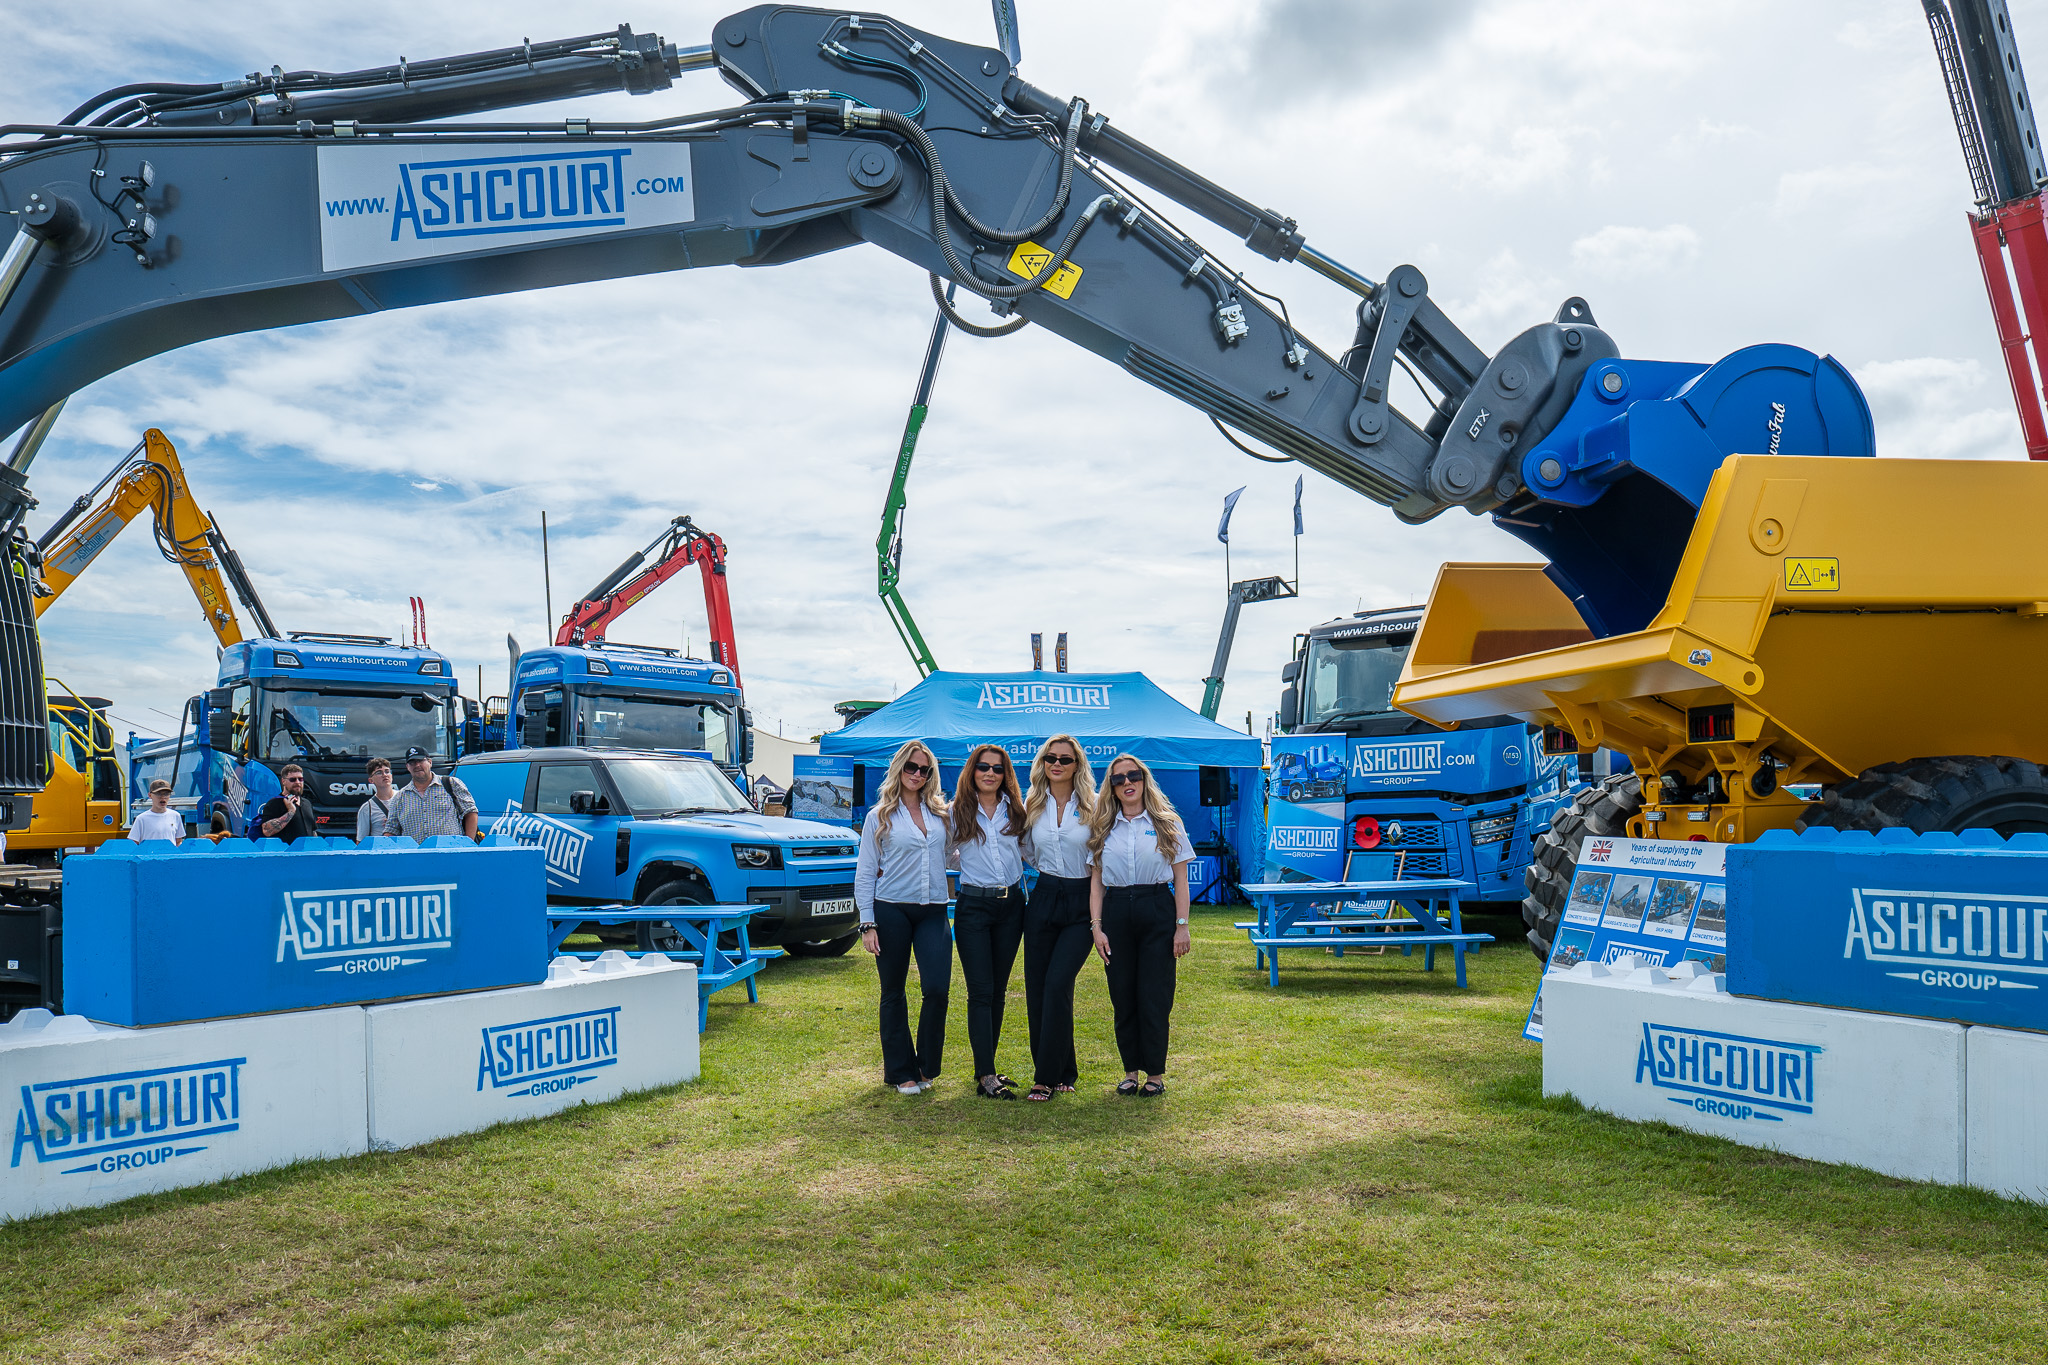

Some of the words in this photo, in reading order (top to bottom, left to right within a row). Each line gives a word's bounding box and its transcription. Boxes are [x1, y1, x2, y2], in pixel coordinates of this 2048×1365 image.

[1469, 408, 1490, 439] GTX
[314, 655, 408, 667] www.ashcourt.com
[618, 663, 698, 677] www.ashcourt.com
[977, 682, 1112, 709] ASHCOURT
[1024, 706, 1069, 714] GROUP
[1505, 752, 1519, 760] M53
[1383, 777, 1413, 785] GROUP
[1268, 826, 1341, 852] ASHCOURT
[1631, 843, 1648, 852] Years
[1648, 844, 1657, 853] of
[1656, 845, 1690, 856] supplying
[1690, 846, 1703, 856] the
[1629, 855, 1668, 866] Agricultural
[1667, 857, 1697, 870] Industry
[815, 901, 836, 914] LA75
[837, 900, 852, 912] VKR
[276, 883, 457, 963] ASHCOURT
[1691, 932, 1714, 941] CONCRETE
[344, 955, 401, 974] GROUP
[1921, 969, 1998, 991] GROUP
[477, 1005, 622, 1091] ASHCOURT
[1635, 1021, 1823, 1115] ASHCOURT
[531, 1075, 577, 1097] GROUP
[10, 1056, 247, 1168] ASHCOURT
[1694, 1097, 1753, 1120] GROUP
[99, 1146, 174, 1173] GROUP
